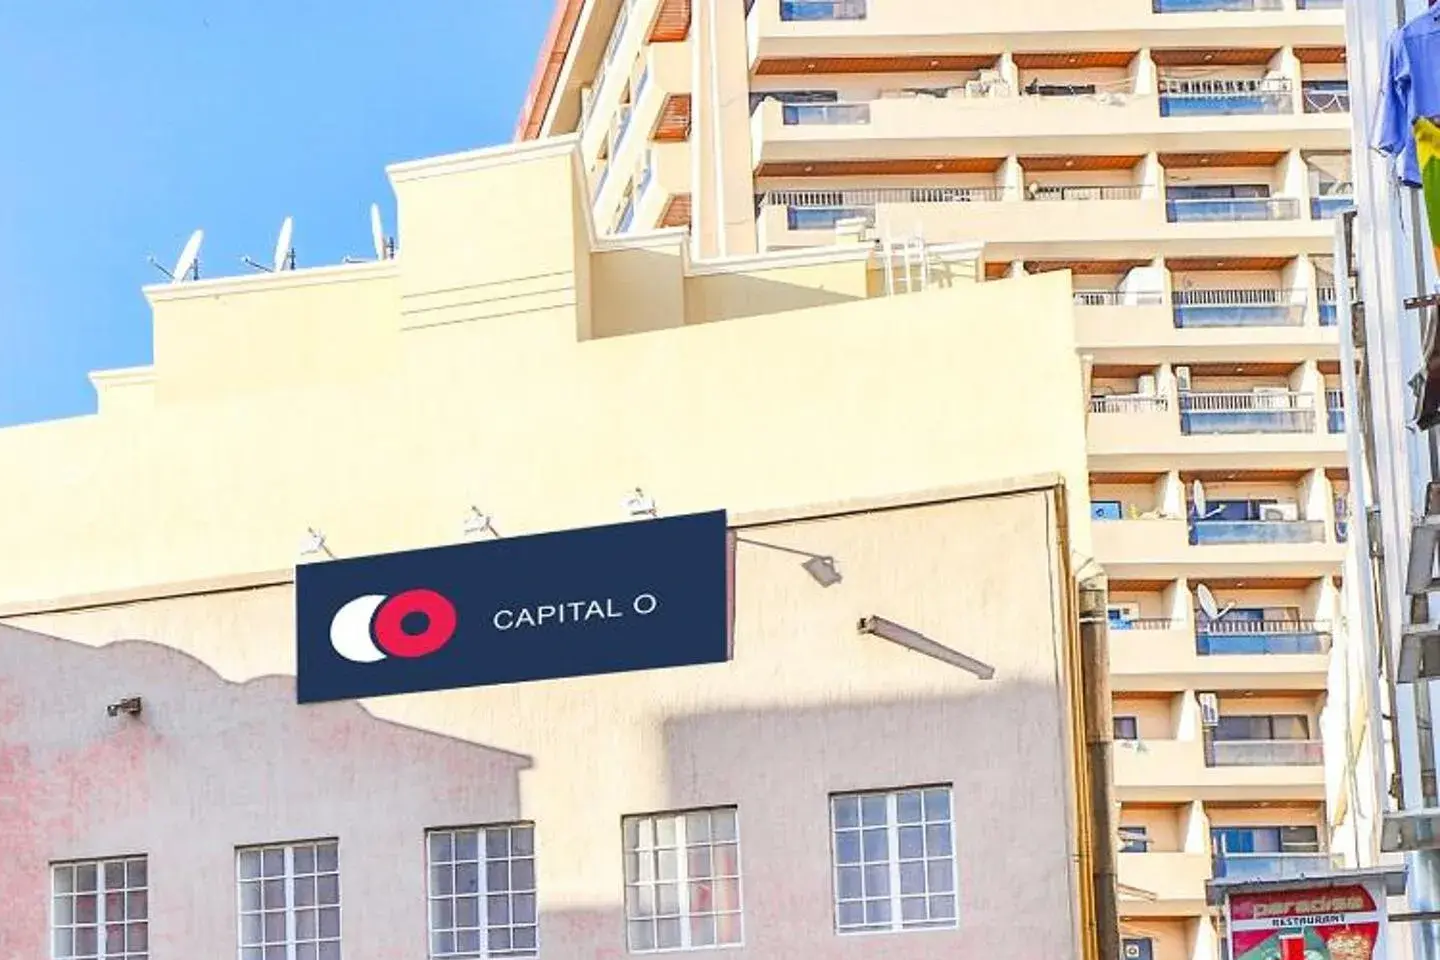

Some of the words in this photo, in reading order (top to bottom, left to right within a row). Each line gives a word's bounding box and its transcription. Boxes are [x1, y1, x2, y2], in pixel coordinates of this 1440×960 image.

[492, 598, 624, 631] CAPITAL
[633, 593, 658, 615] O
[1271, 914, 1346, 928] RESTAURANT
